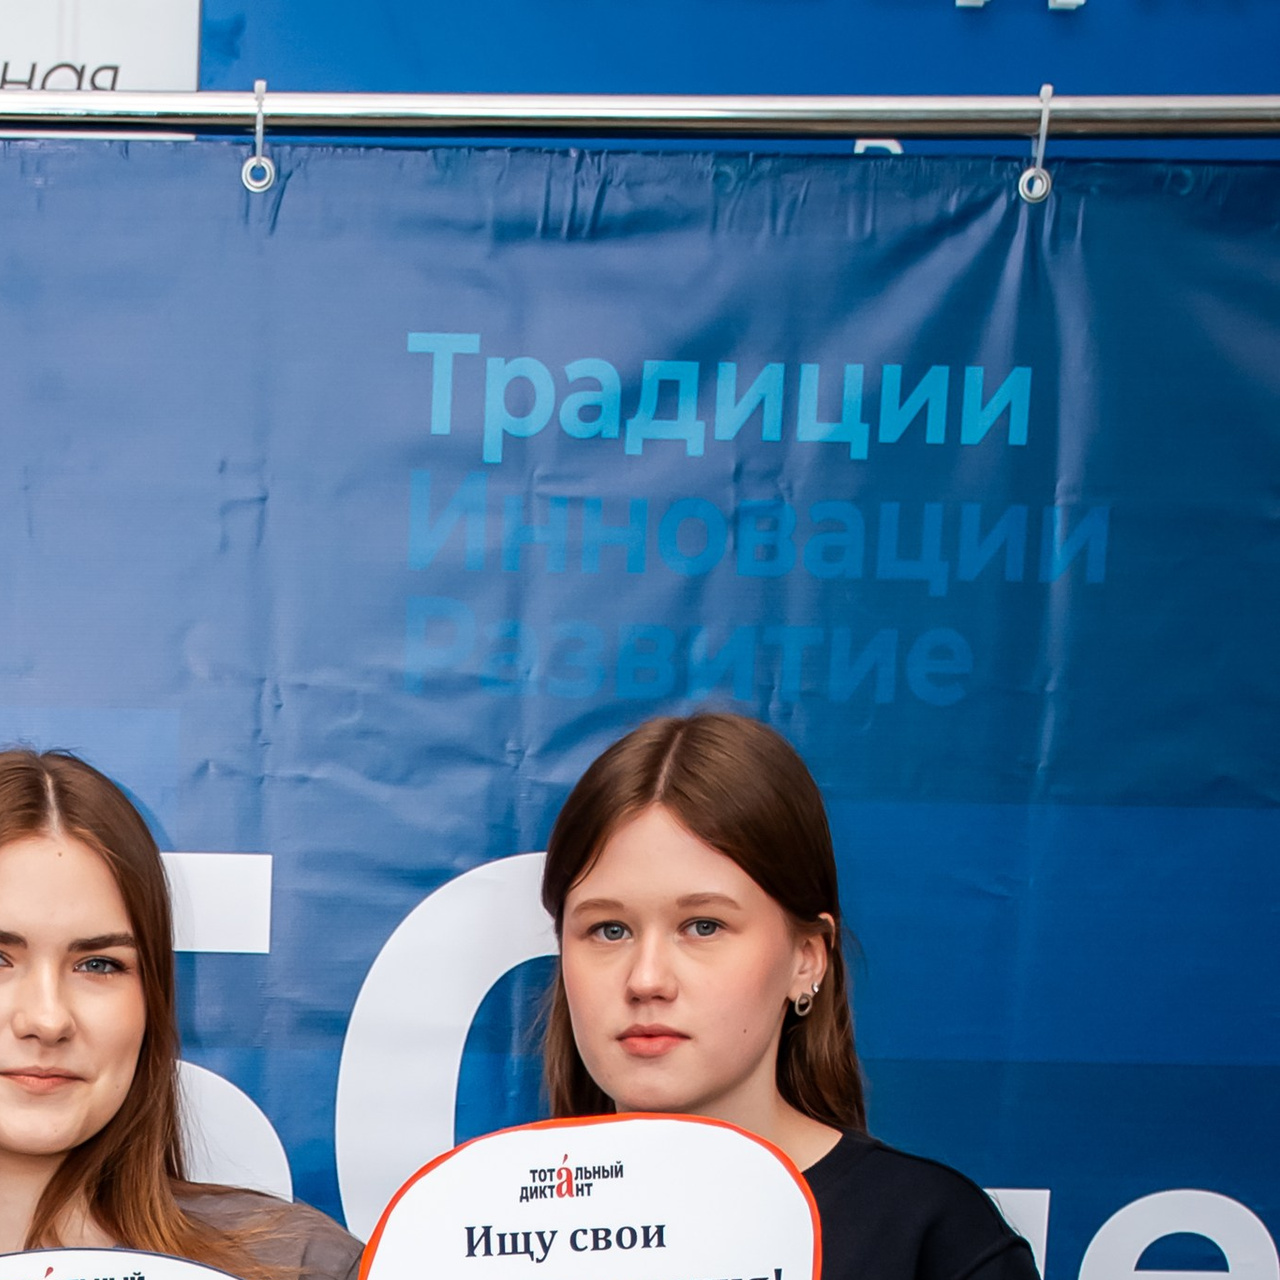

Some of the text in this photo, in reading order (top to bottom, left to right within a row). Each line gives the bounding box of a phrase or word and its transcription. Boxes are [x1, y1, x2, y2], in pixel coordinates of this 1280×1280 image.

[407, 332, 1033, 463] Традиции
[405, 469, 1113, 596] Инновации
[400, 595, 975, 706] Развитие
[465, 1222, 667, 1263] Ищу свои
